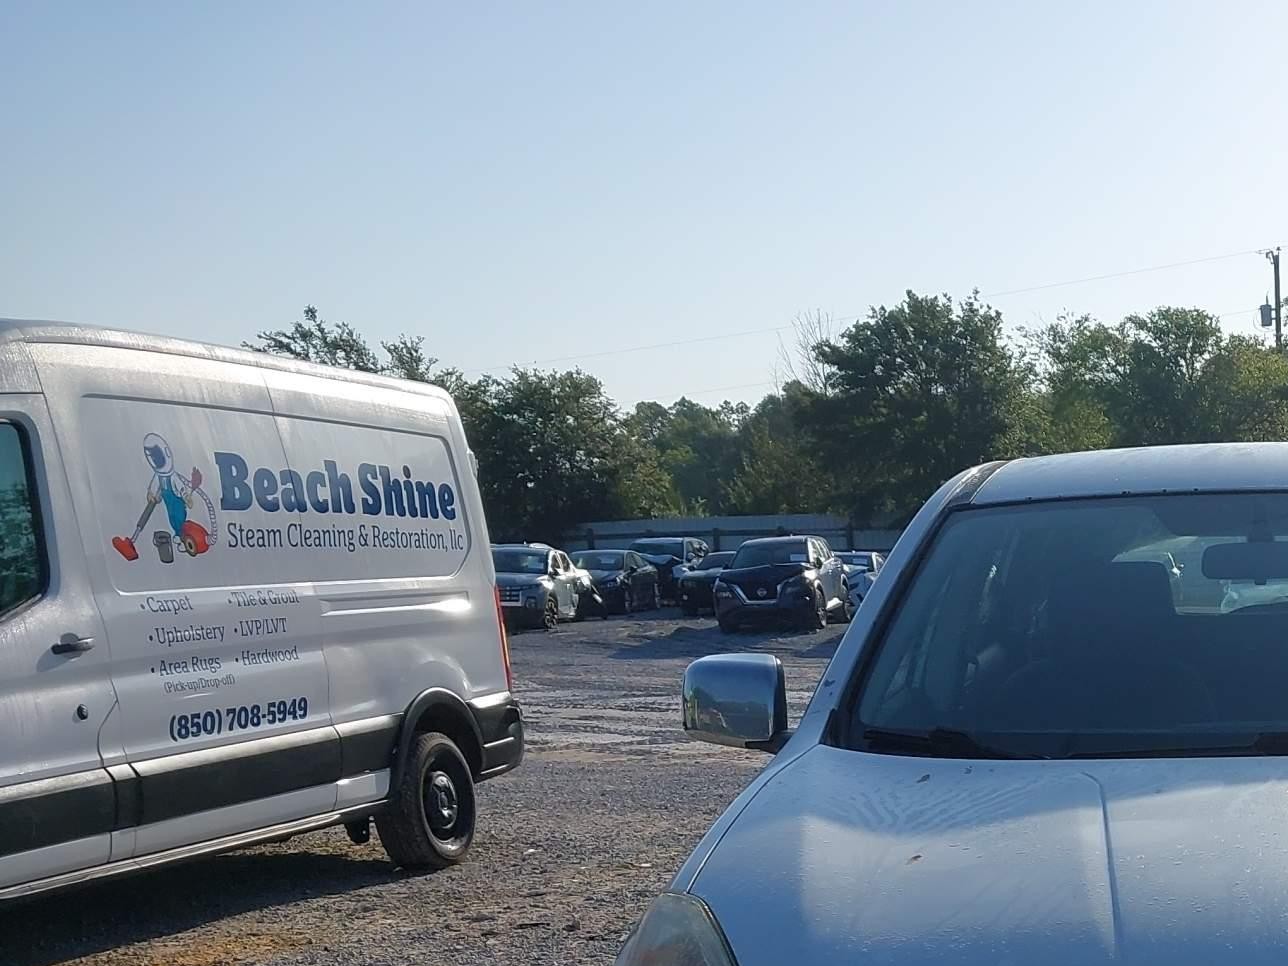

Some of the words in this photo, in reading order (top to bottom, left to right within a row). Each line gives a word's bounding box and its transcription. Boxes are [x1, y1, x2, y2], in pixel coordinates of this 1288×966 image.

[213, 451, 356, 515] Beach
[358, 462, 457, 521] Shine
[227, 522, 284, 548] Steam
[287, 523, 356, 553] Cleaning
[358, 524, 369, 548] &
[371, 525, 449, 552] Restoration,
[449, 528, 464, 550] llc
[146, 595, 194, 615] Carpet
[230, 591, 257, 607] Tile
[257, 590, 268, 606] &
[267, 589, 300, 605] Grout
[154, 625, 225, 647] Upholstery
[240, 617, 287, 637] LVP/LVT
[241, 645, 300, 666] Hardwood
[159, 659, 190, 677] Area
[192, 656, 222, 673] Rugs
[163, 674, 236, 694] (Pick-up/Drop-off)
[169, 708, 223, 742] (850)
[226, 696, 309, 731] 708-5949
